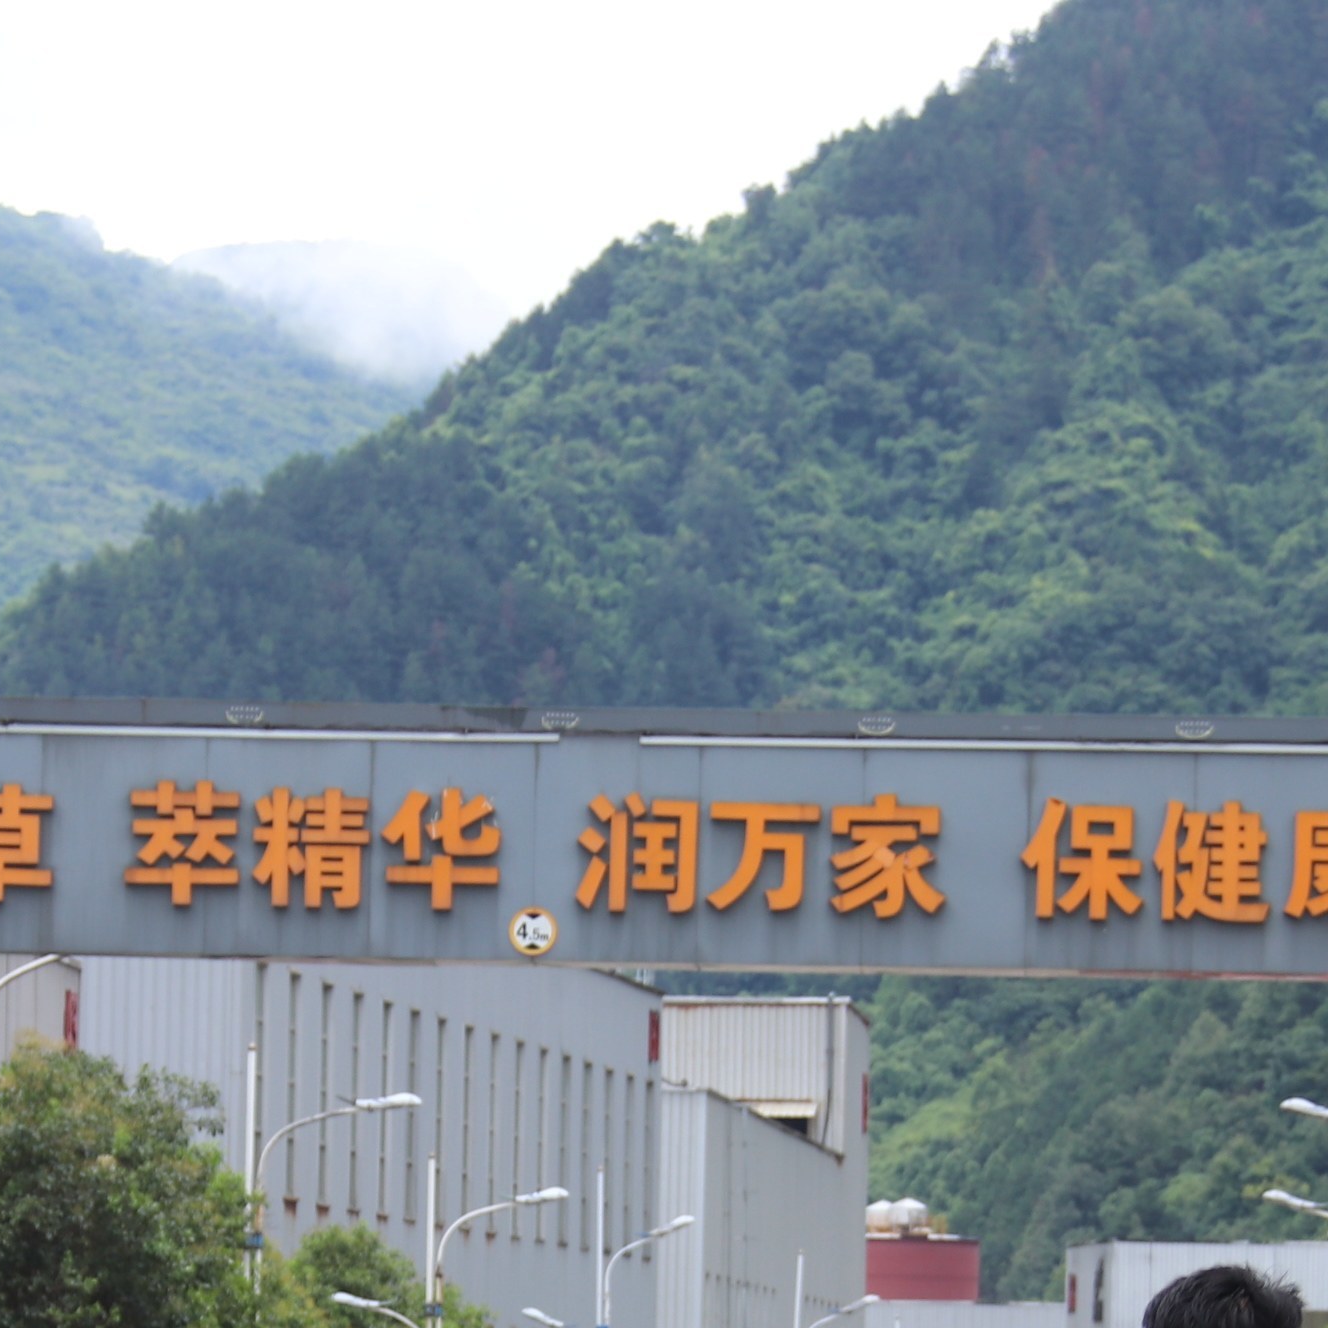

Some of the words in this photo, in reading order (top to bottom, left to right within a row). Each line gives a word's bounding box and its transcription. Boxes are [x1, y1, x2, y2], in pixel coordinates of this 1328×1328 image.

[124, 780, 502, 910] 萃精华
[575, 793, 945, 919] 润万家
[516, 921, 550, 941] 4.5m
